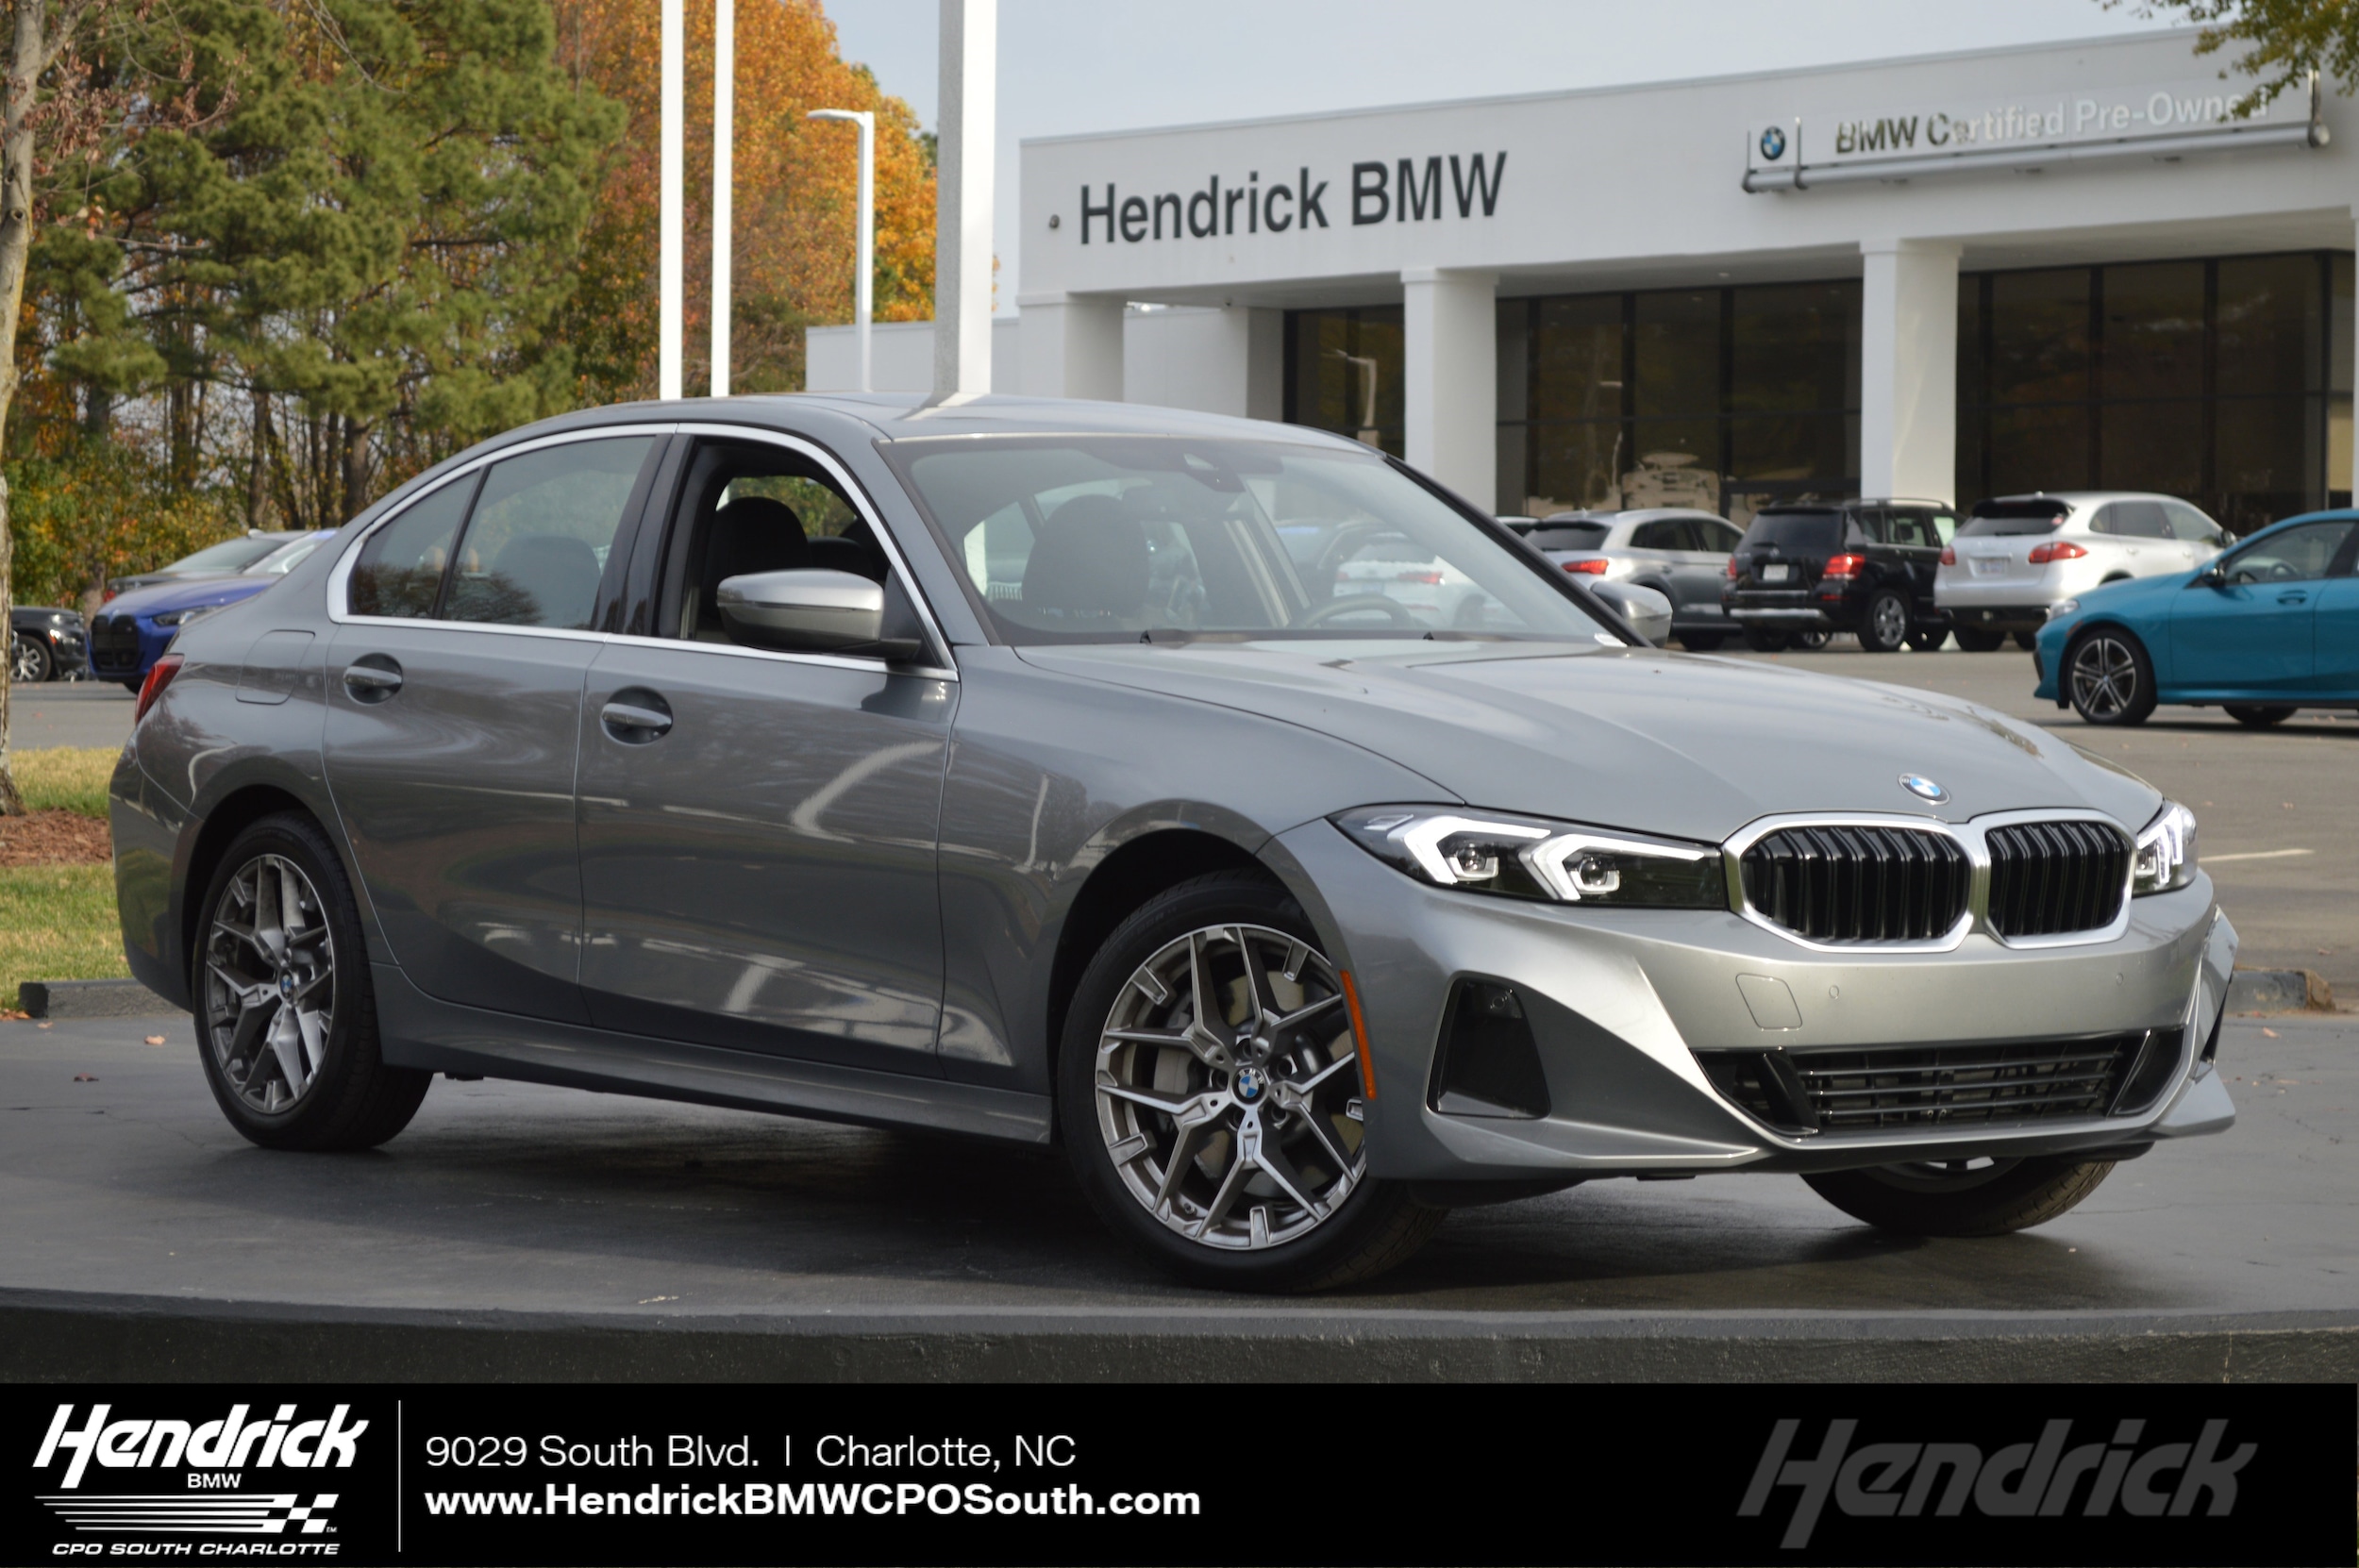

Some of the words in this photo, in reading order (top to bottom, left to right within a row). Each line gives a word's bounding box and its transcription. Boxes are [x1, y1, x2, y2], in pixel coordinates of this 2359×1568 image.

[1835, 115, 1918, 154] BMW
[1927, 101, 2066, 146] Certified
[1080, 166, 1330, 245] Hendrick
[1351, 151, 1508, 226] BMW
